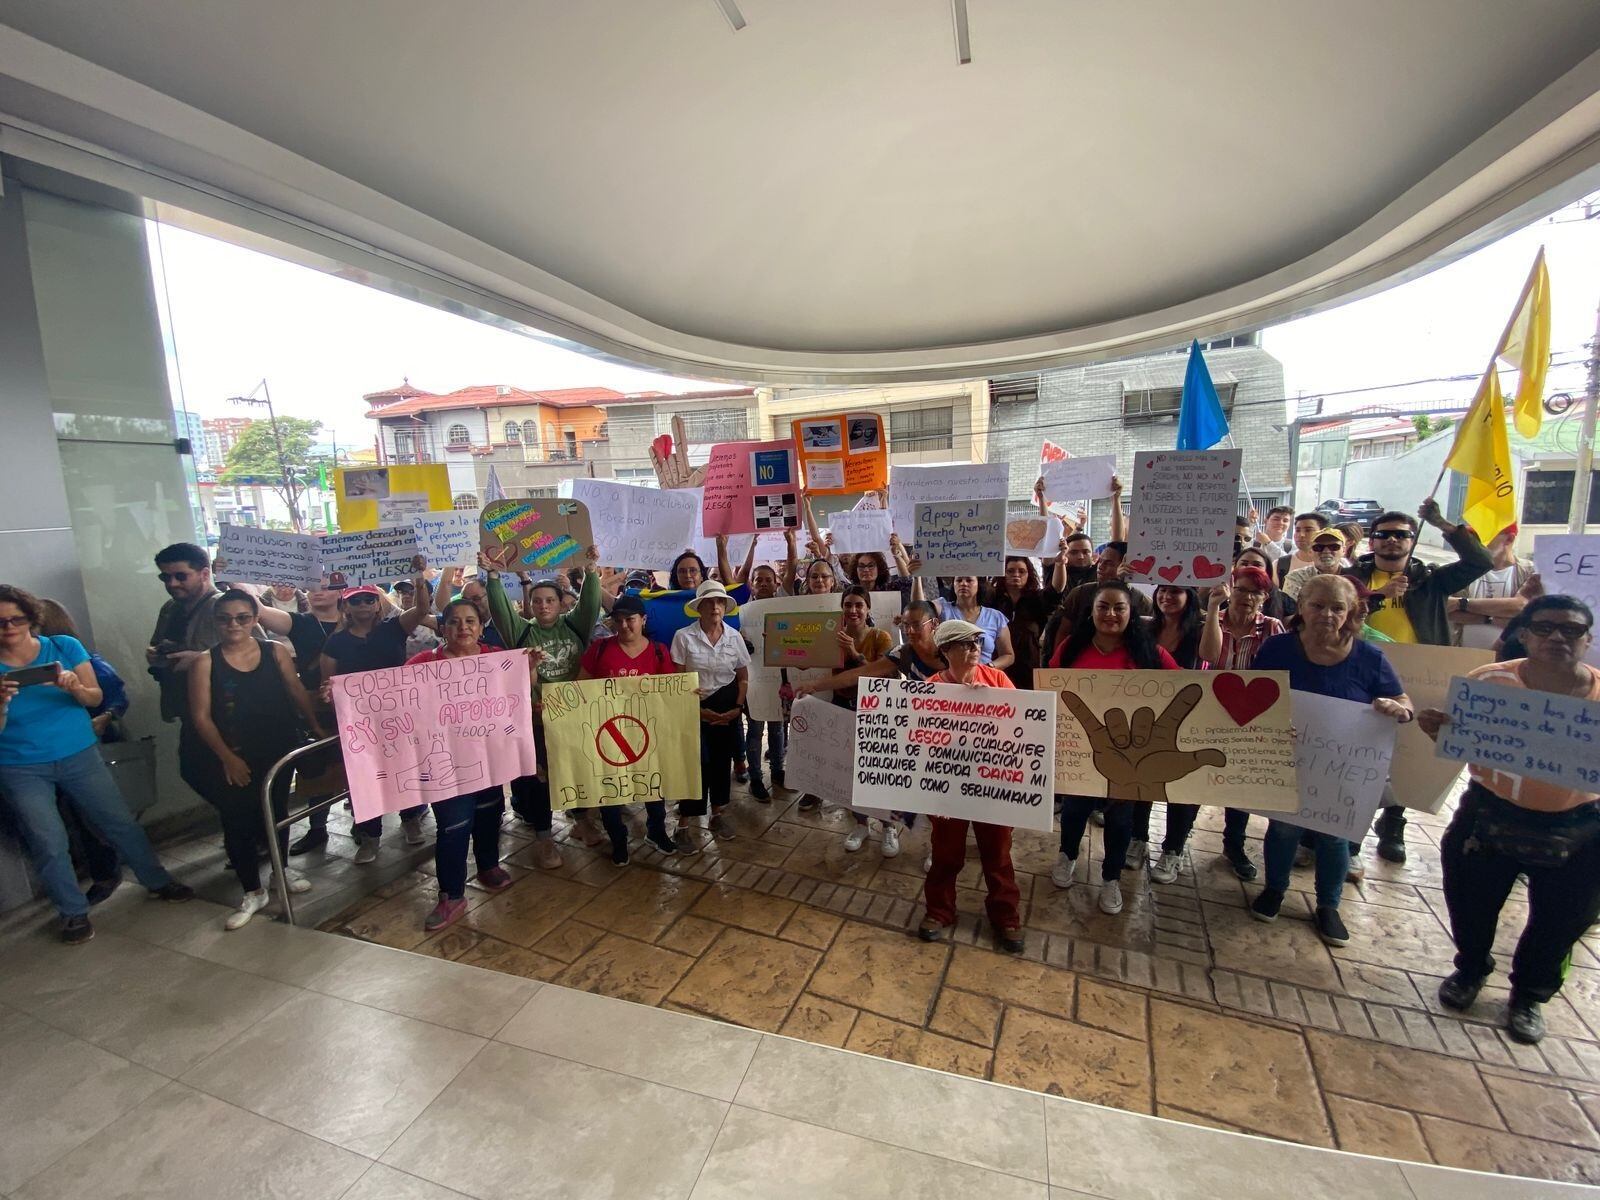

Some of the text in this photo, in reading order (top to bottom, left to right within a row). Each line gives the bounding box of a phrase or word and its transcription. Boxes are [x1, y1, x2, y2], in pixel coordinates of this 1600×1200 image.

[760, 465, 775, 480] NO
[366, 527, 407, 540] derecho
[429, 530, 469, 545] personas
[916, 525, 955, 540] derecho
[959, 523, 1000, 538] humano
[344, 656, 494, 699] GOBIERNO DE
[868, 679, 936, 695] LEY 9822
[1036, 669, 1071, 692] Ley
[1110, 673, 1176, 698] 7600
[355, 676, 489, 715] COSTA RICA
[543, 674, 691, 722] ¡NO! AL CIERRE
[860, 695, 1047, 722] NO A LA DISCRIMINACIÓN POR
[1520, 702, 1530, 711] a
[1544, 699, 1565, 720] los
[346, 694, 520, 754] ¿Y SU APOYO?
[407, 734, 420, 746] la
[454, 723, 496, 740] 7600?
[858, 714, 1024, 738] FALTA DE INFORMACIÓN O
[1538, 720, 1555, 734] de
[1566, 725, 1592, 742] las
[858, 727, 1046, 758] EVITAR LESCO O CUALQUIER
[858, 741, 1041, 771] FORMA DE COMUNICACIÓN O
[1474, 748, 1515, 764] 7600
[858, 756, 1047, 788] CUALQUIER MEDIDA DAÑA MI
[858, 771, 913, 789] DIGNIDAD
[920, 777, 950, 794] COMO
[1323, 759, 1379, 786] MEP
[560, 772, 665, 806] DE SESA
